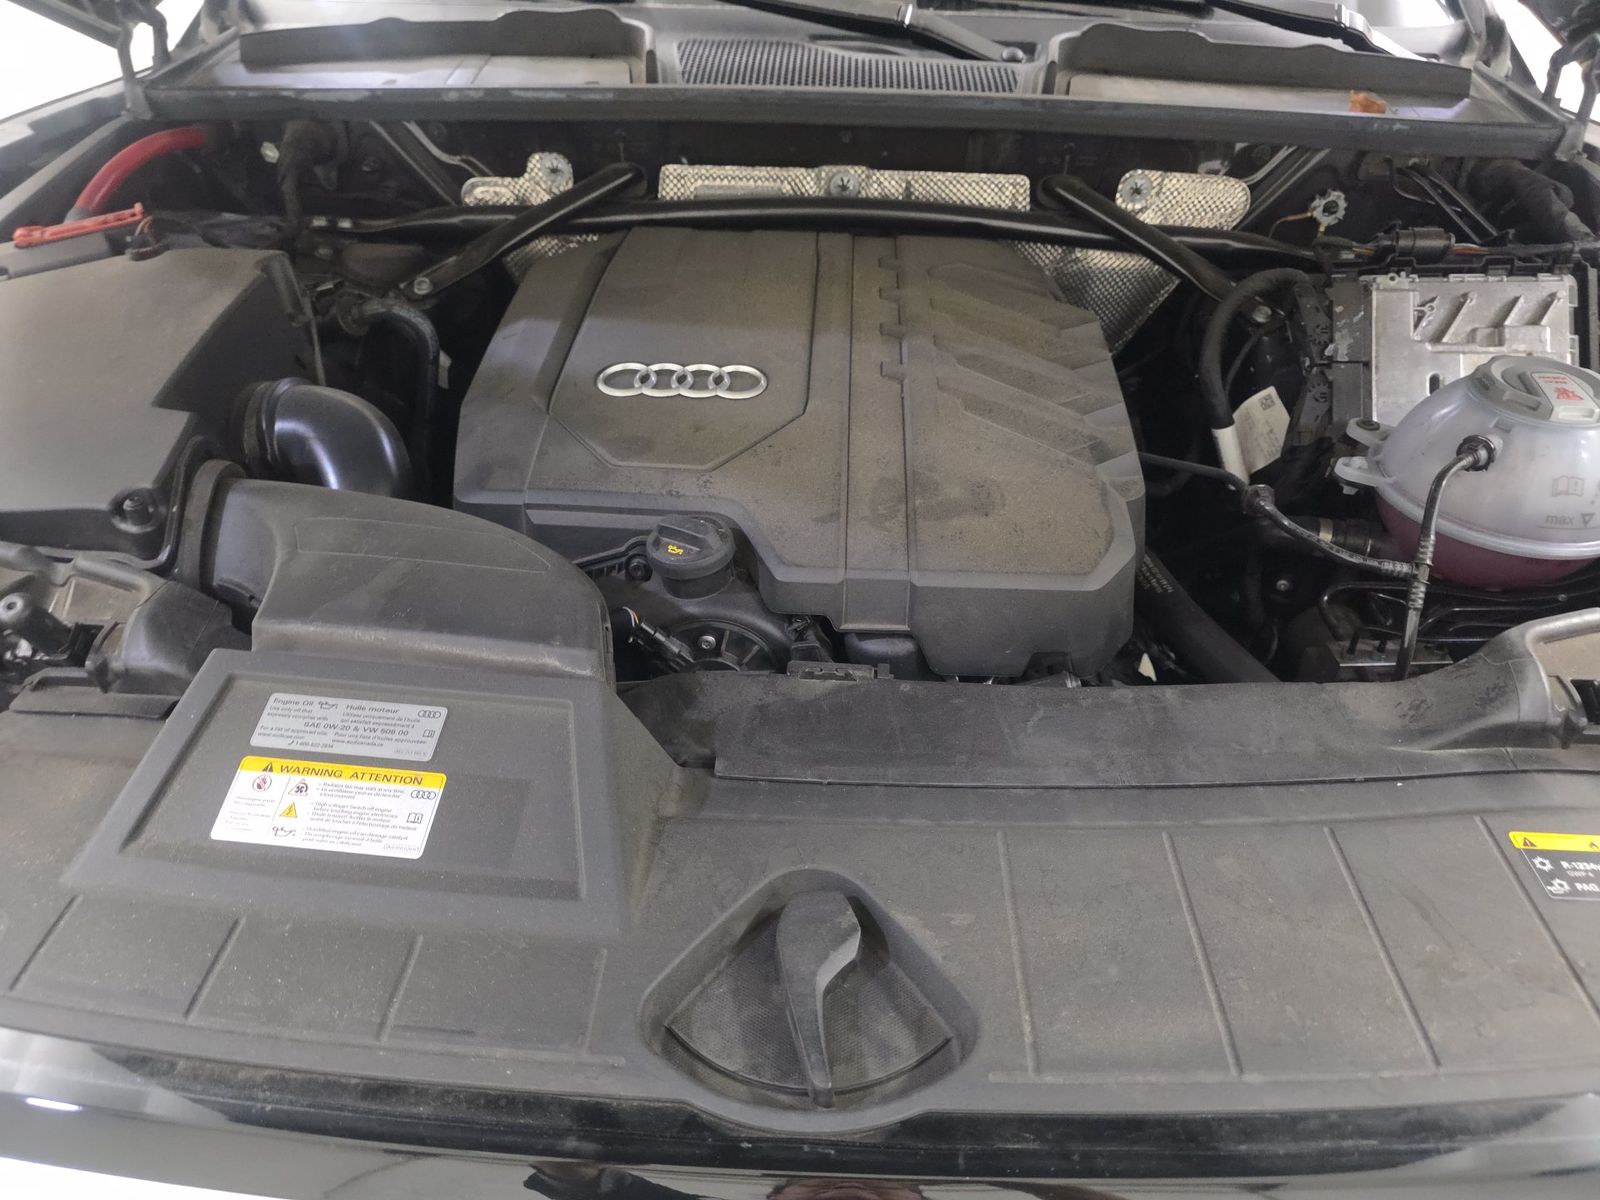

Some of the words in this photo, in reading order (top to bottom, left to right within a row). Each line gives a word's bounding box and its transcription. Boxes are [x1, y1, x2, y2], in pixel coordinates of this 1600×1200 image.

[1545, 514, 1574, 525] max
[274, 698, 299, 706] Engine
[281, 765, 343, 778] WARNING
[350, 771, 423, 785] ATTENTION
